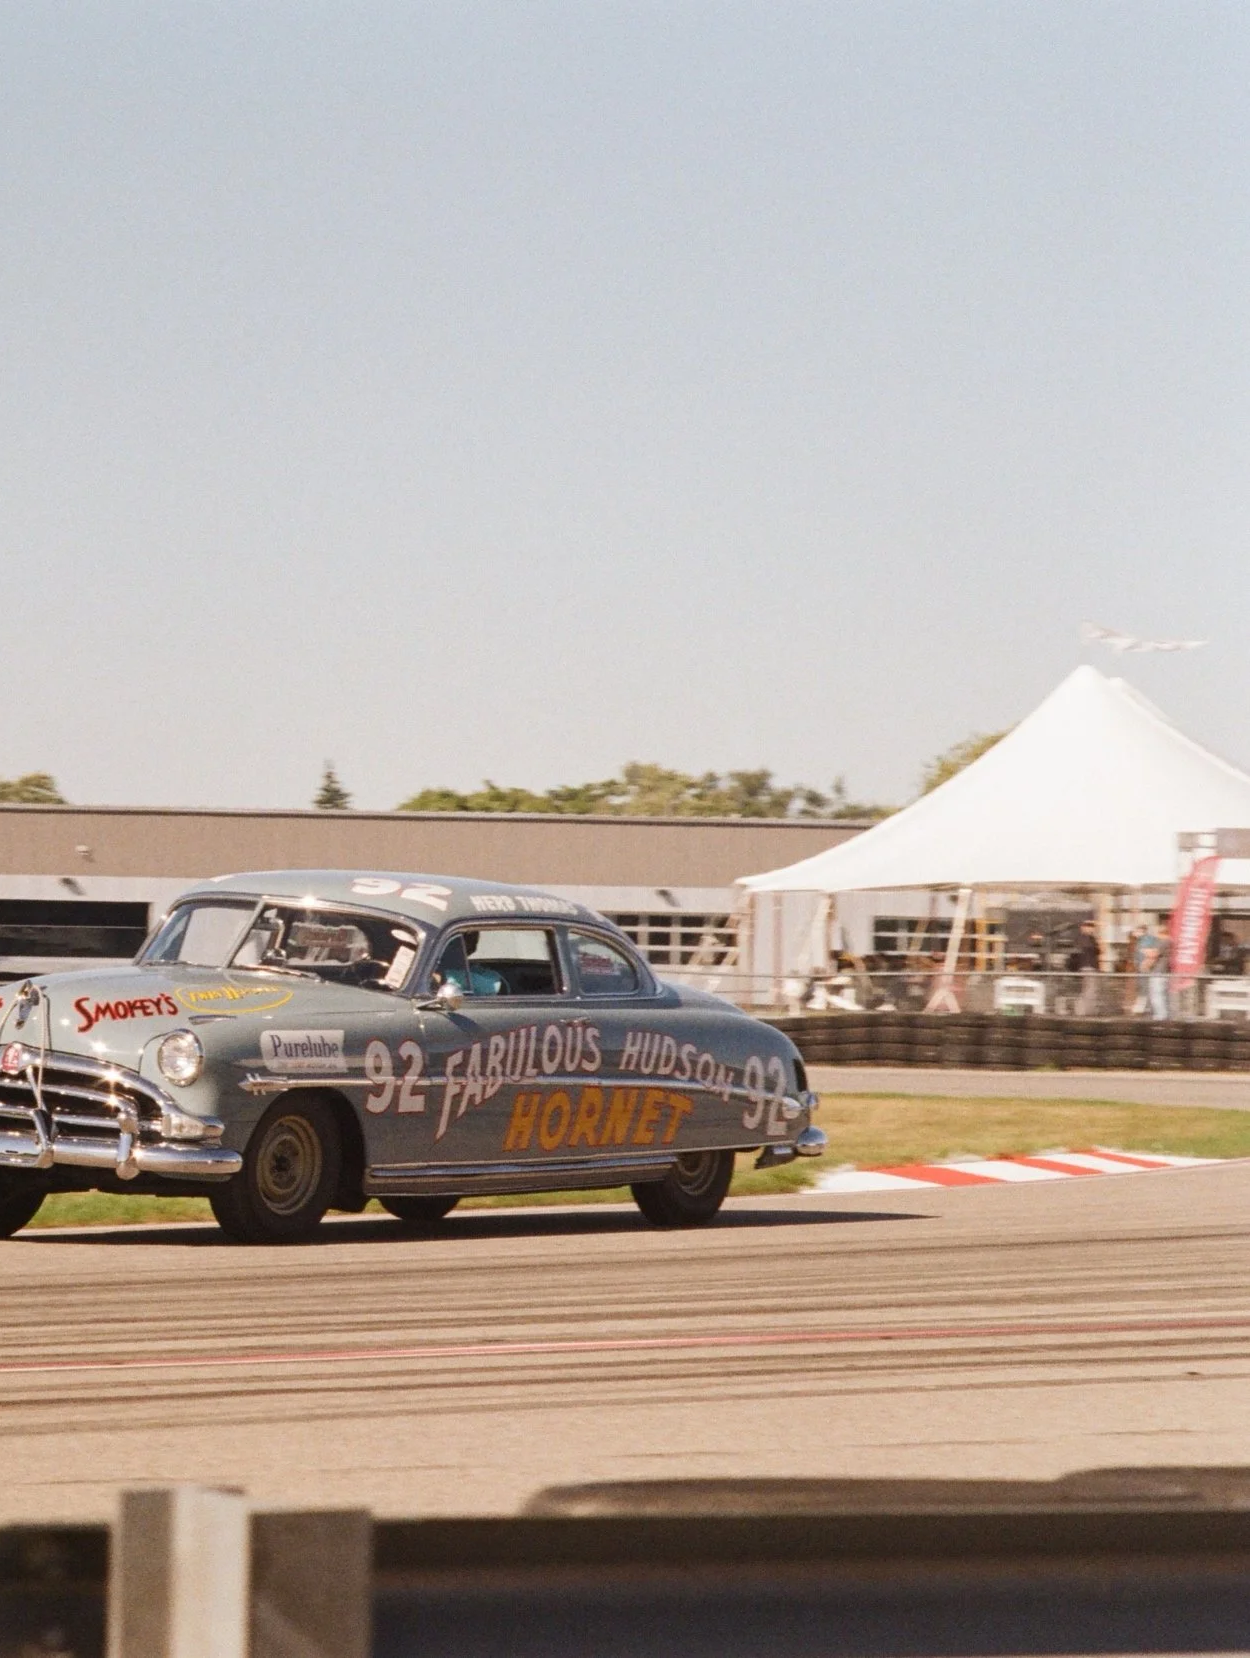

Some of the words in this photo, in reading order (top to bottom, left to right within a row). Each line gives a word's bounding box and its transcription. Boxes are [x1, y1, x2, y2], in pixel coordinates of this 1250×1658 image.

[351, 877, 452, 912] 92
[74, 992, 179, 1034] SMOKEY'S
[269, 1034, 340, 1059] Purelube
[364, 1037, 426, 1115] 92
[433, 1023, 603, 1145] FABULOUS
[618, 1030, 735, 1104] HUDSON
[742, 1055, 788, 1136] 92
[502, 1084, 695, 1152] HORNET
